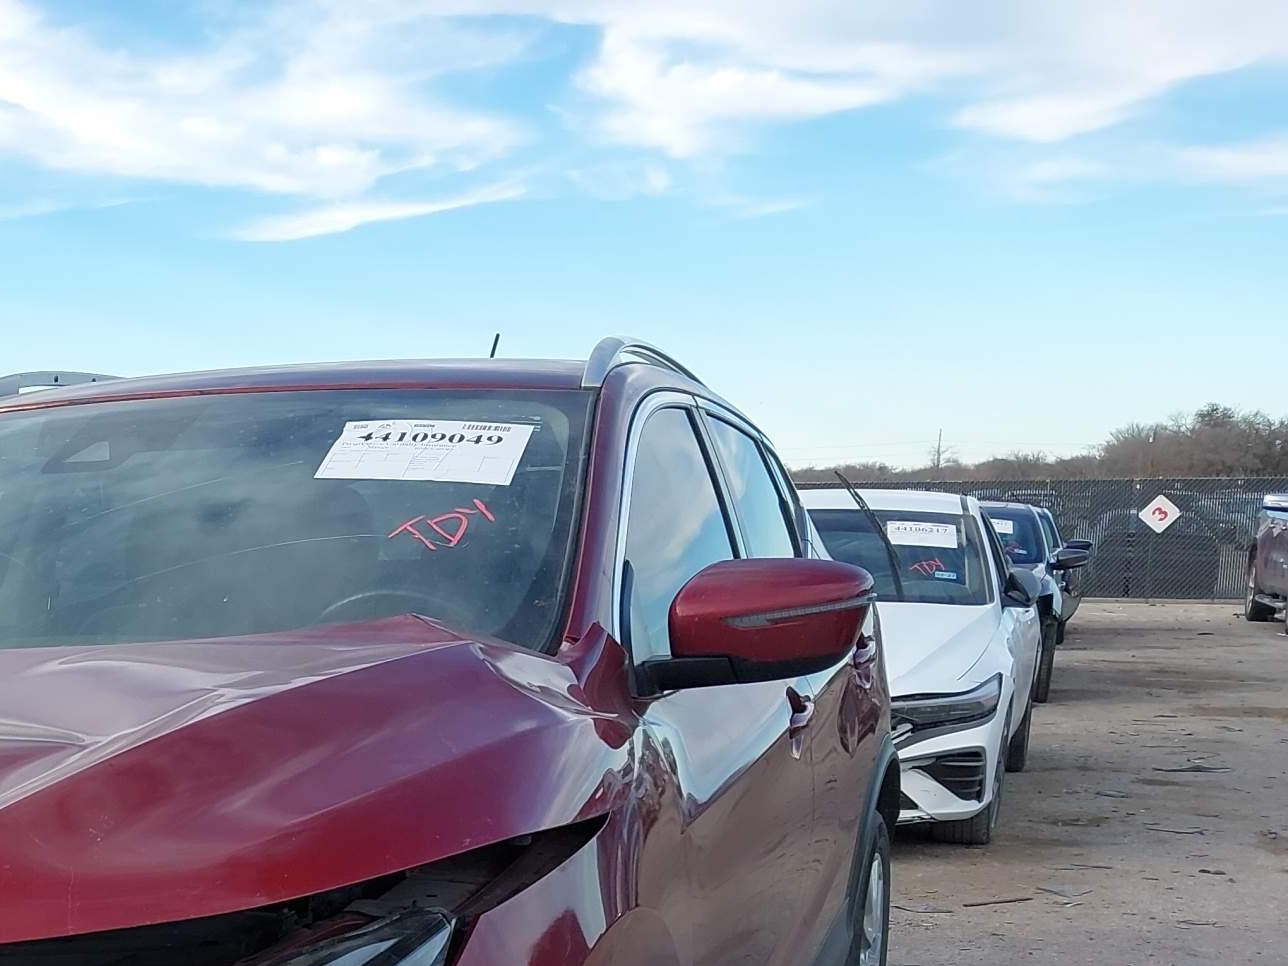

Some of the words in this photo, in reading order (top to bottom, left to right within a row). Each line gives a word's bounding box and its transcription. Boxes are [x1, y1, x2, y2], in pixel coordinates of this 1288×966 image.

[357, 431, 504, 446] 44109049
[1152, 507, 1169, 522] 3
[388, 498, 496, 550] TDY
[909, 558, 945, 576] TDY
